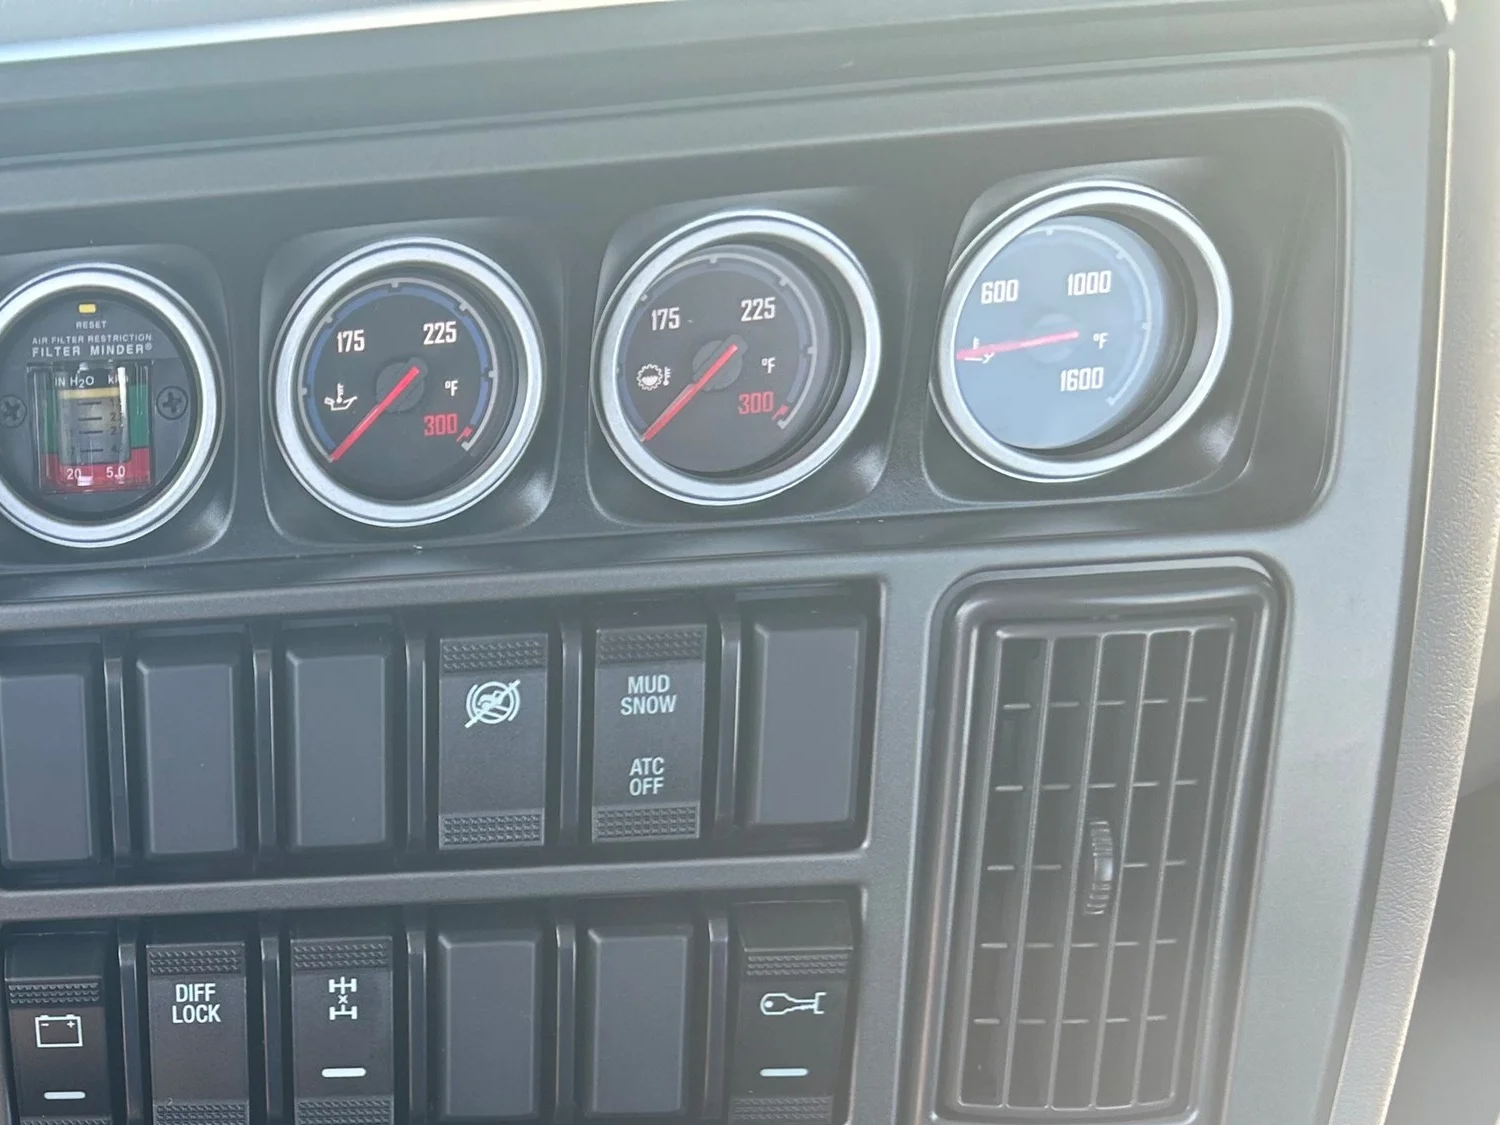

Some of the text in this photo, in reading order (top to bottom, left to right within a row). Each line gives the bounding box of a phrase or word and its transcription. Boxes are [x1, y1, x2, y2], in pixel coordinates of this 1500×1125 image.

[981, 279, 1019, 304] 600
[1067, 270, 1112, 296] 1000
[651, 307, 680, 331] 175
[740, 297, 776, 322] 225
[75, 320, 107, 329] RESET
[423, 321, 457, 345] 225
[32, 333, 152, 345] AIR FILTER RESTRICTION
[337, 329, 365, 353] 175
[32, 346, 81, 358] FILTER
[55, 377, 66, 387] IN
[1060, 366, 1104, 392] 1600
[738, 391, 775, 415] 300
[423, 413, 458, 436] 300
[66, 468, 82, 480] 20
[627, 674, 671, 694] MUD
[620, 694, 677, 715] SNOW
[629, 757, 665, 776] ATC
[629, 777, 664, 796] OFF
[175, 983, 216, 1003] DIFF
[172, 1004, 221, 1024] LOCK
